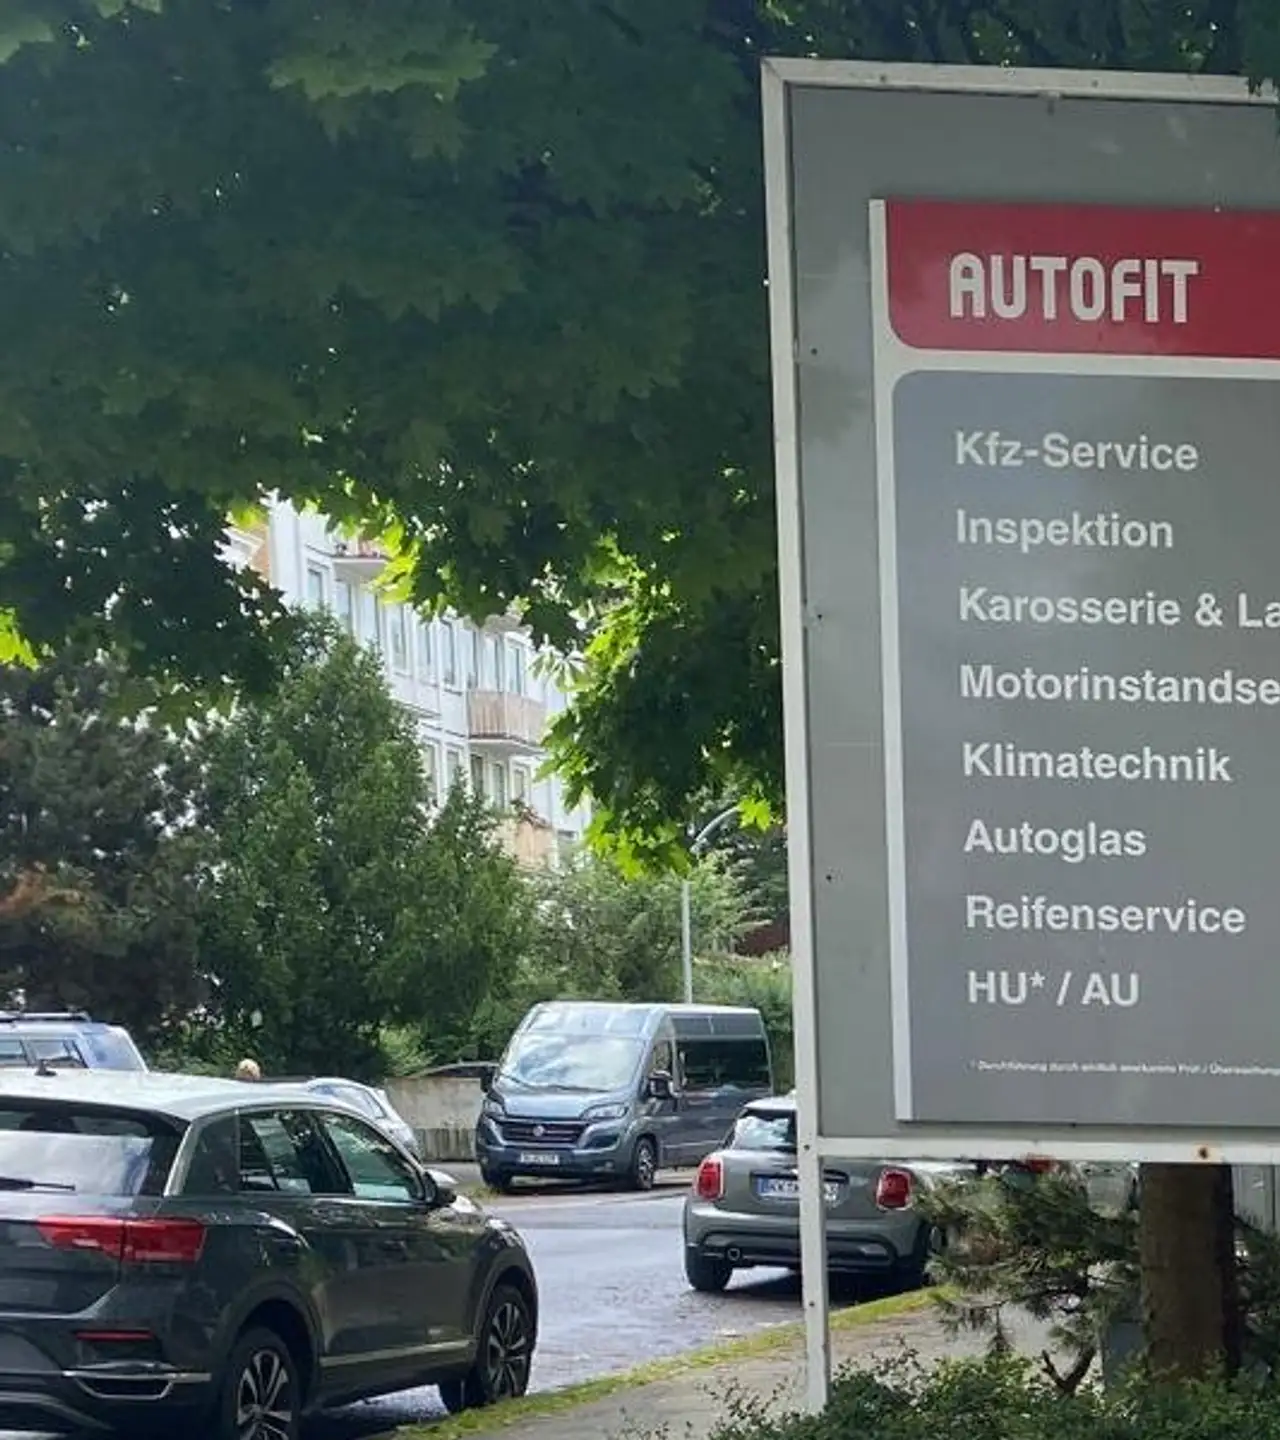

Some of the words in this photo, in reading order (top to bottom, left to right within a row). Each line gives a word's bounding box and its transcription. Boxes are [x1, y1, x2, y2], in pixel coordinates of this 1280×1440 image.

[949, 252, 1199, 324] AUTOFIT
[957, 431, 1199, 470] Kfz-Service
[957, 509, 1174, 553] Inspektion
[960, 588, 1181, 626] Karosserie
[1195, 593, 1224, 626] &
[964, 742, 1232, 781] Klimatechnik
[964, 820, 1147, 863] Autoglas
[967, 894, 1246, 933] Reifenservice
[1057, 971, 1073, 1006] /
[1082, 973, 1140, 1007] AU
